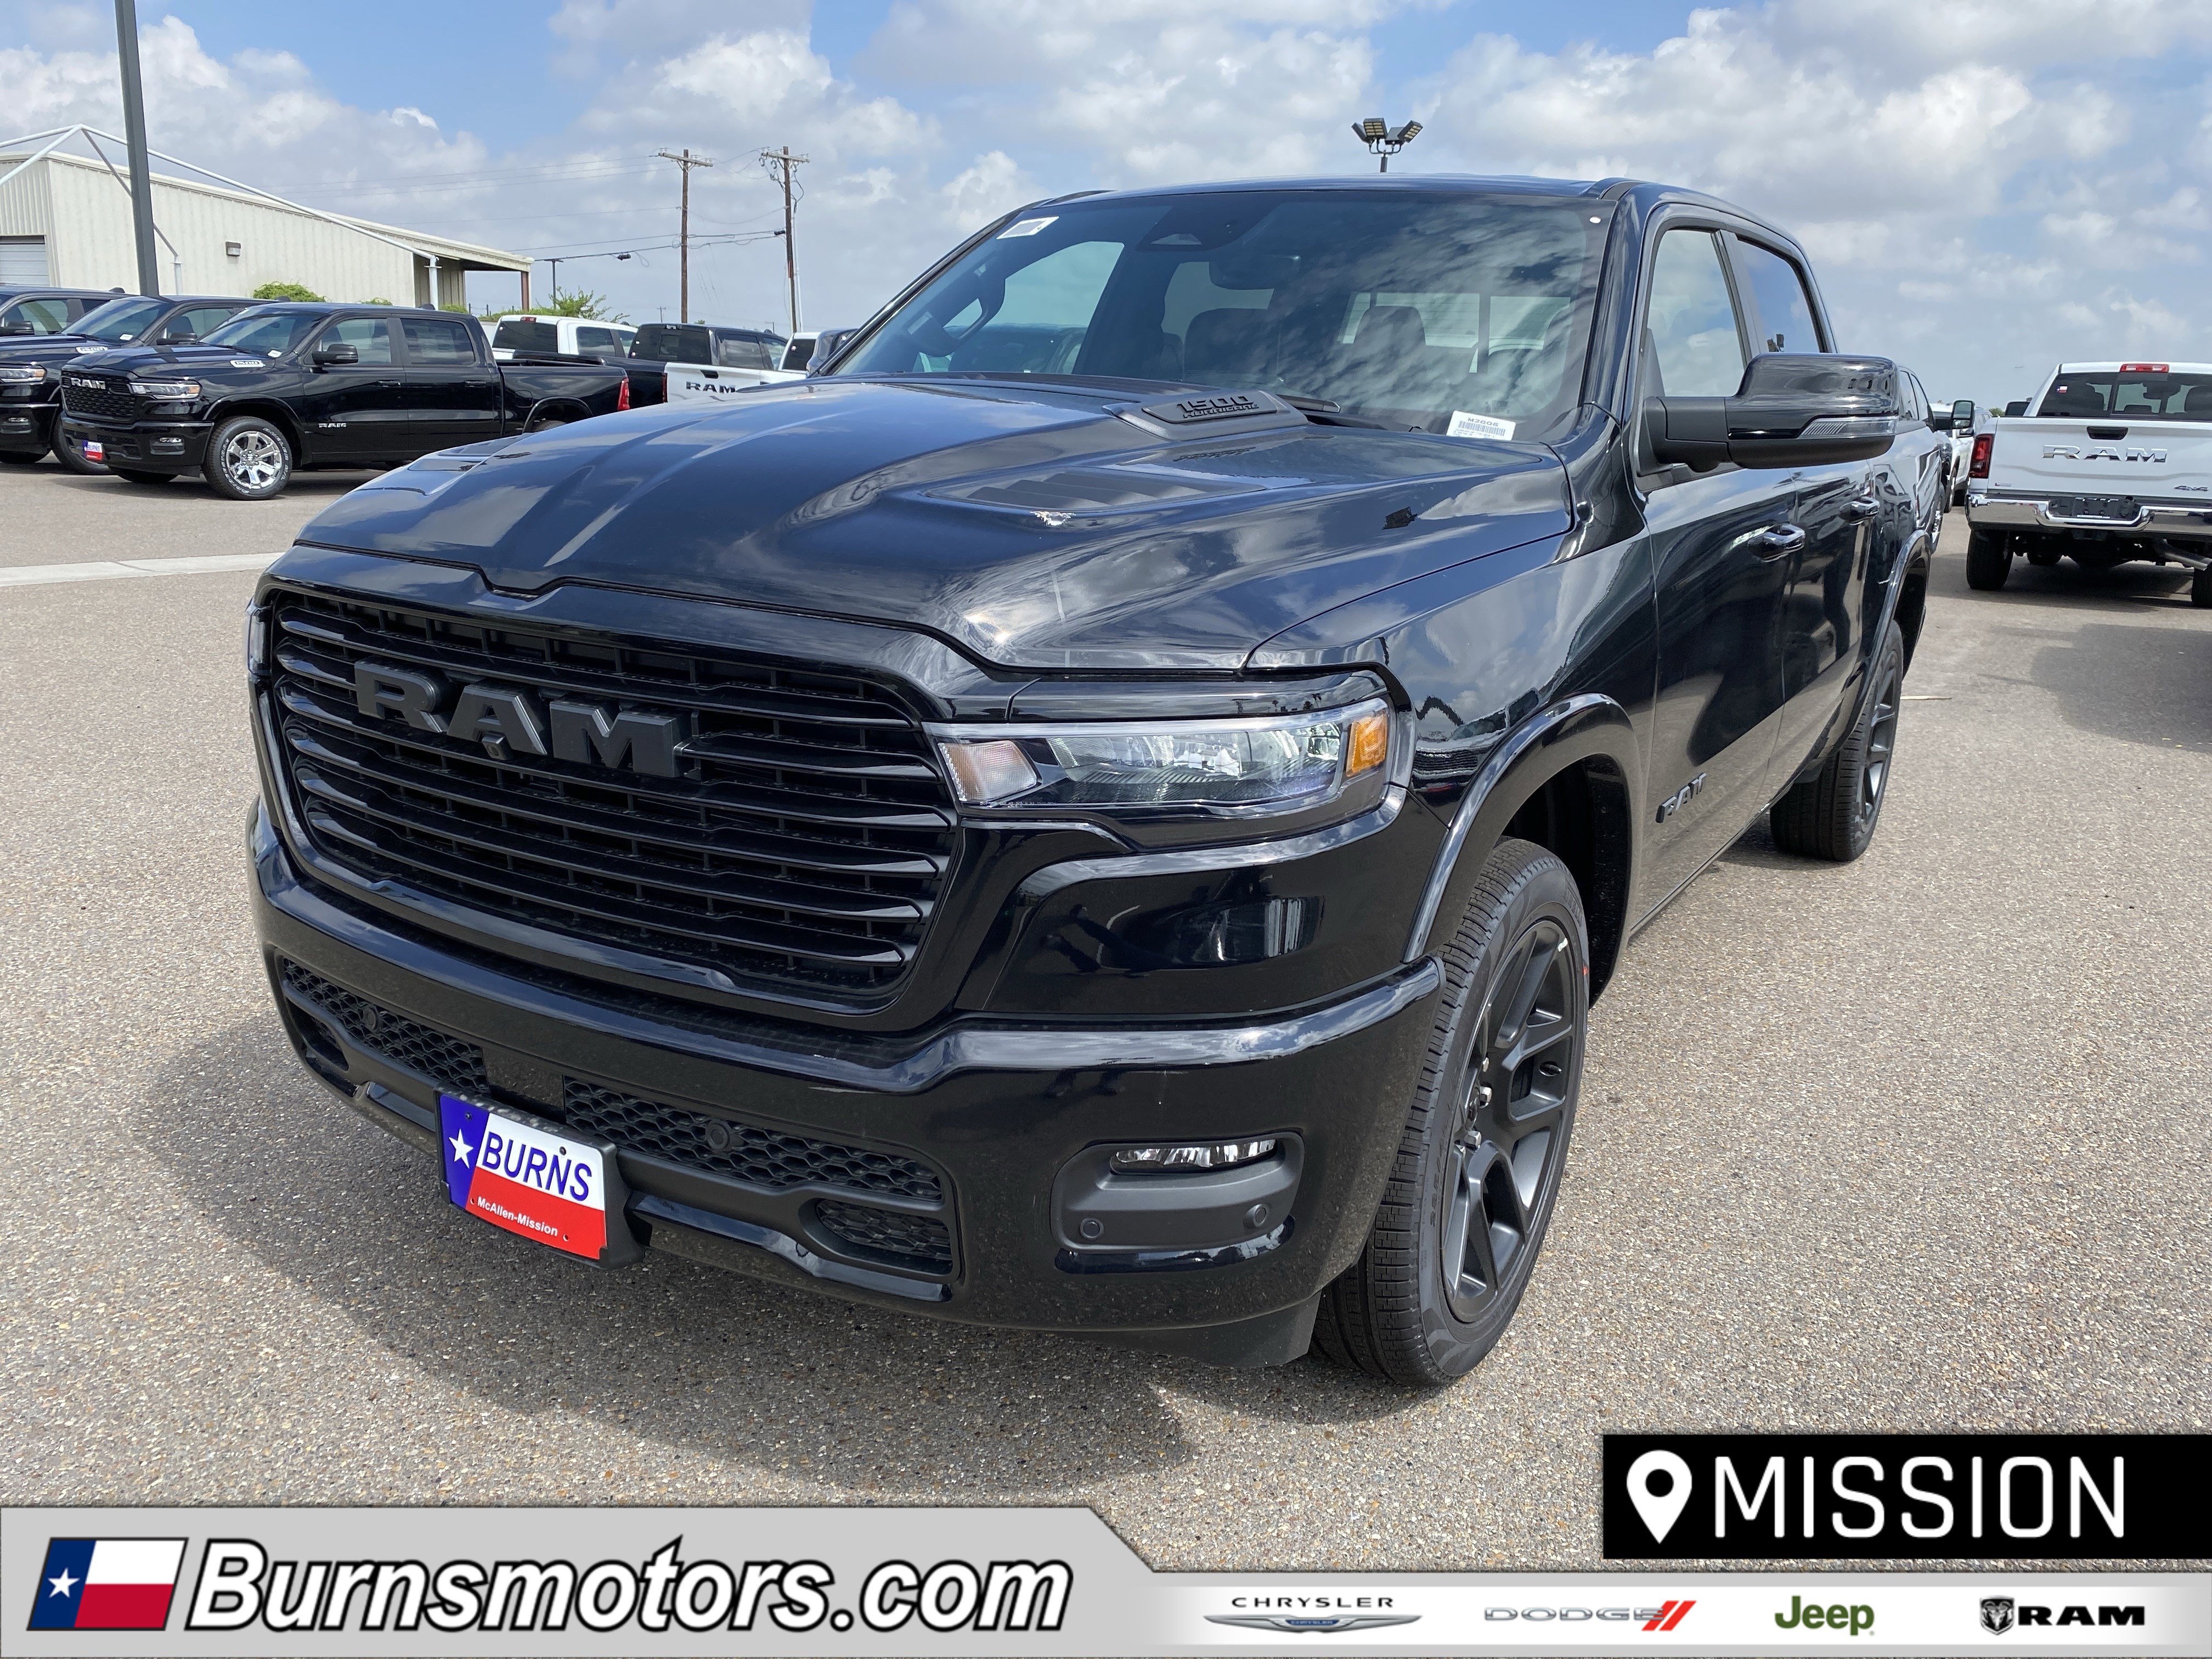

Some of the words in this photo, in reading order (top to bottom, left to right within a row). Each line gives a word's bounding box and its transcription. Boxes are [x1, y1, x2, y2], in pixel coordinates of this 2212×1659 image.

[70, 377, 106, 390] RAM
[686, 381, 736, 394] RAM
[1176, 396, 1255, 413] 1500
[1183, 404, 1260, 419] HURRICANE
[2042, 445, 2168, 463] RAM
[354, 660, 678, 778] RAM
[1655, 772, 1707, 823] RAM
[482, 1131, 592, 1201] BURNS
[477, 1196, 558, 1237] McAllen-Mission
